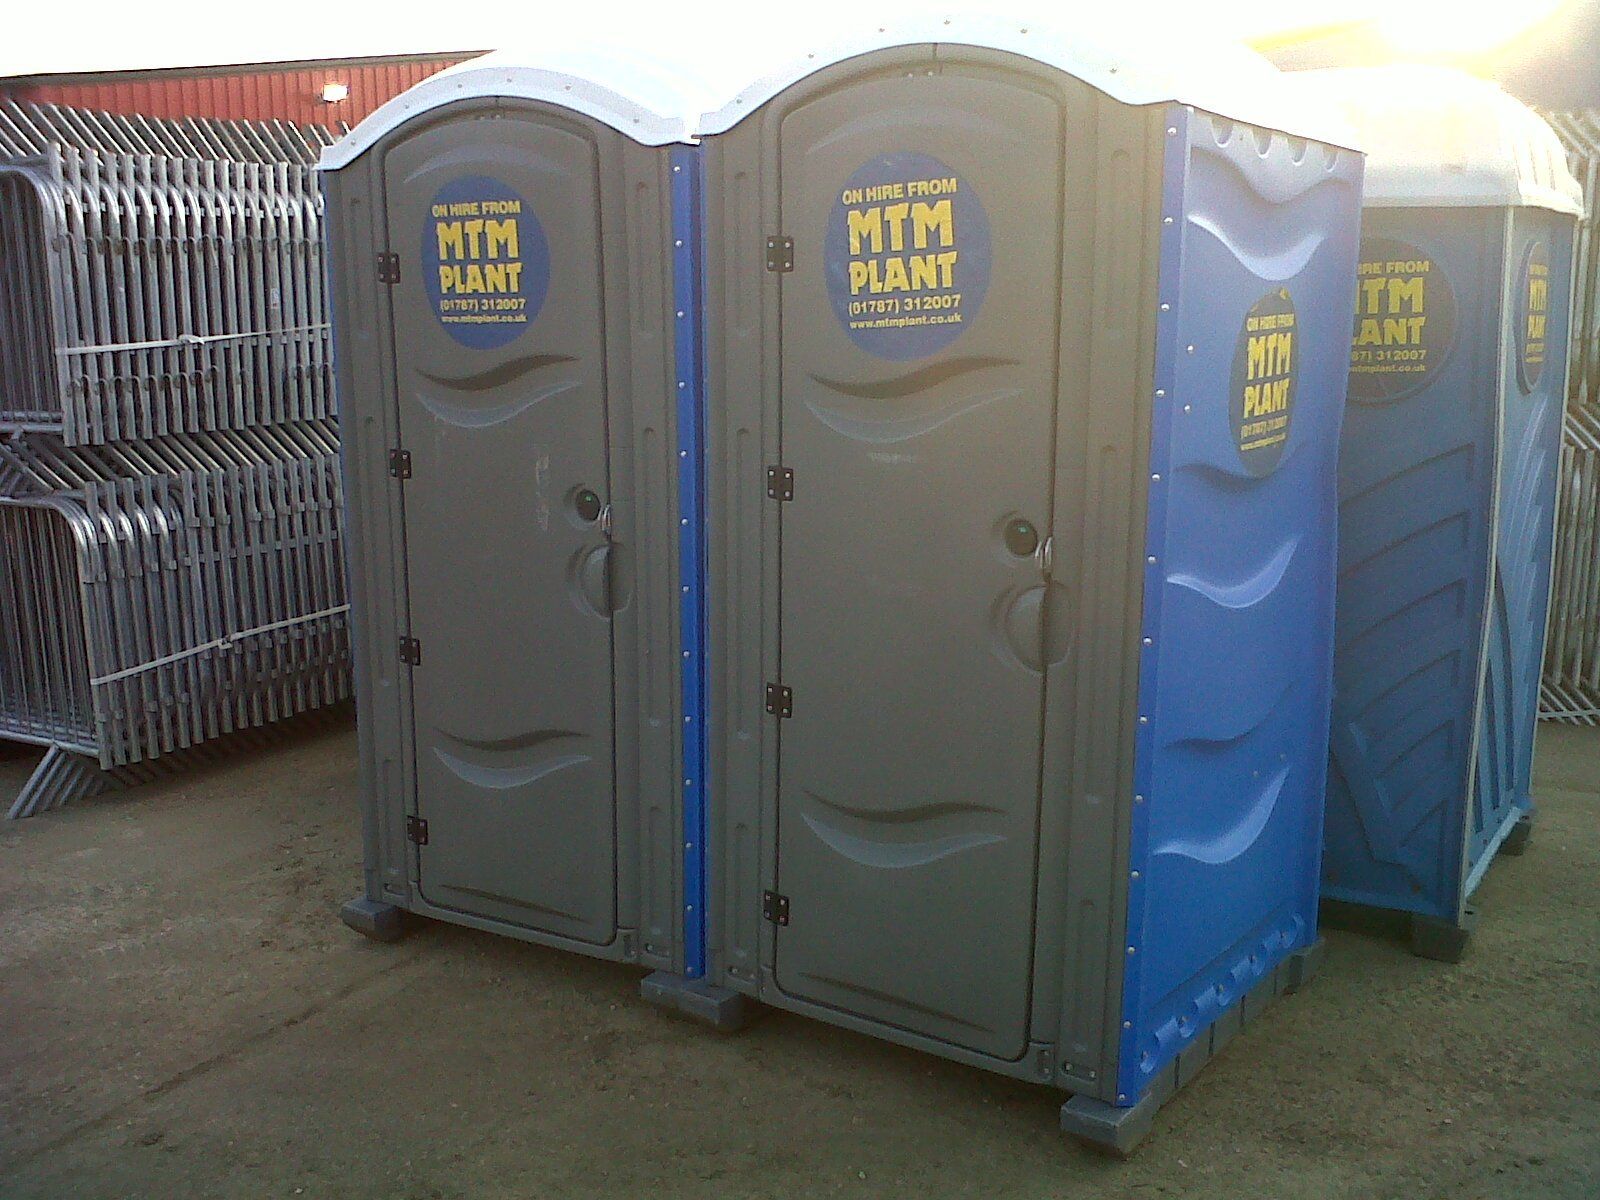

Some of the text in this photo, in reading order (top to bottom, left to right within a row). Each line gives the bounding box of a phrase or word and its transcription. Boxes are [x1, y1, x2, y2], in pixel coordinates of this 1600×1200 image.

[842, 189, 863, 206] ON
[907, 178, 957, 197] FROM
[432, 204, 448, 217] ON
[482, 201, 520, 214] FROM
[437, 219, 518, 259] MTM
[847, 200, 953, 255] MTM
[440, 262, 522, 293] PLANT
[849, 251, 957, 295] PLANT
[1386, 260, 1430, 273] FROM
[441, 298, 526, 312] (01787) 312007
[849, 294, 961, 316] (01787) 312007
[850, 312, 962, 328] www.mtmplant.co.uk
[1247, 332, 1291, 380] MTM
[1376, 349, 1427, 361] 312007
[1244, 378, 1289, 418] PLANT
